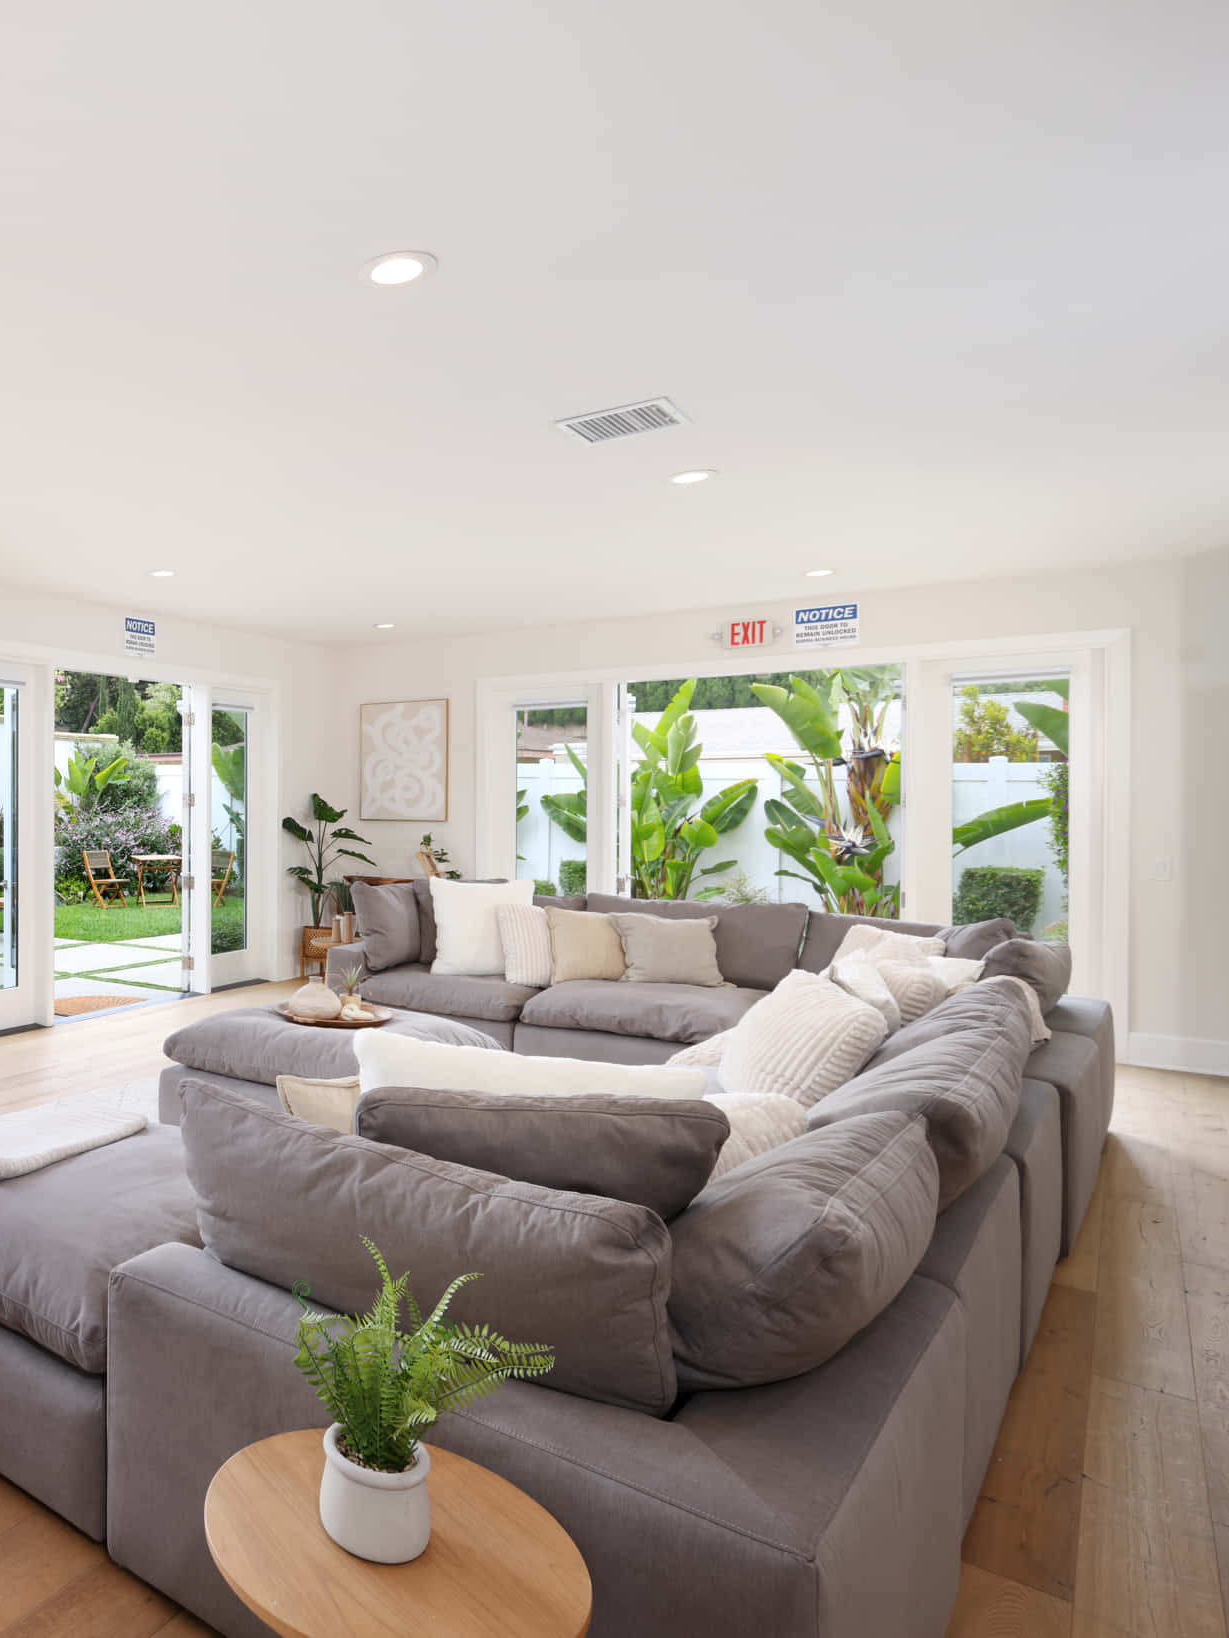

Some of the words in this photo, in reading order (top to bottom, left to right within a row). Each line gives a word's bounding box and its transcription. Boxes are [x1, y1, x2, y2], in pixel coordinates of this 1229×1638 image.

[798, 607, 855, 622] NOTICE
[127, 619, 154, 634] NOTICE
[731, 620, 767, 646] EXIT
